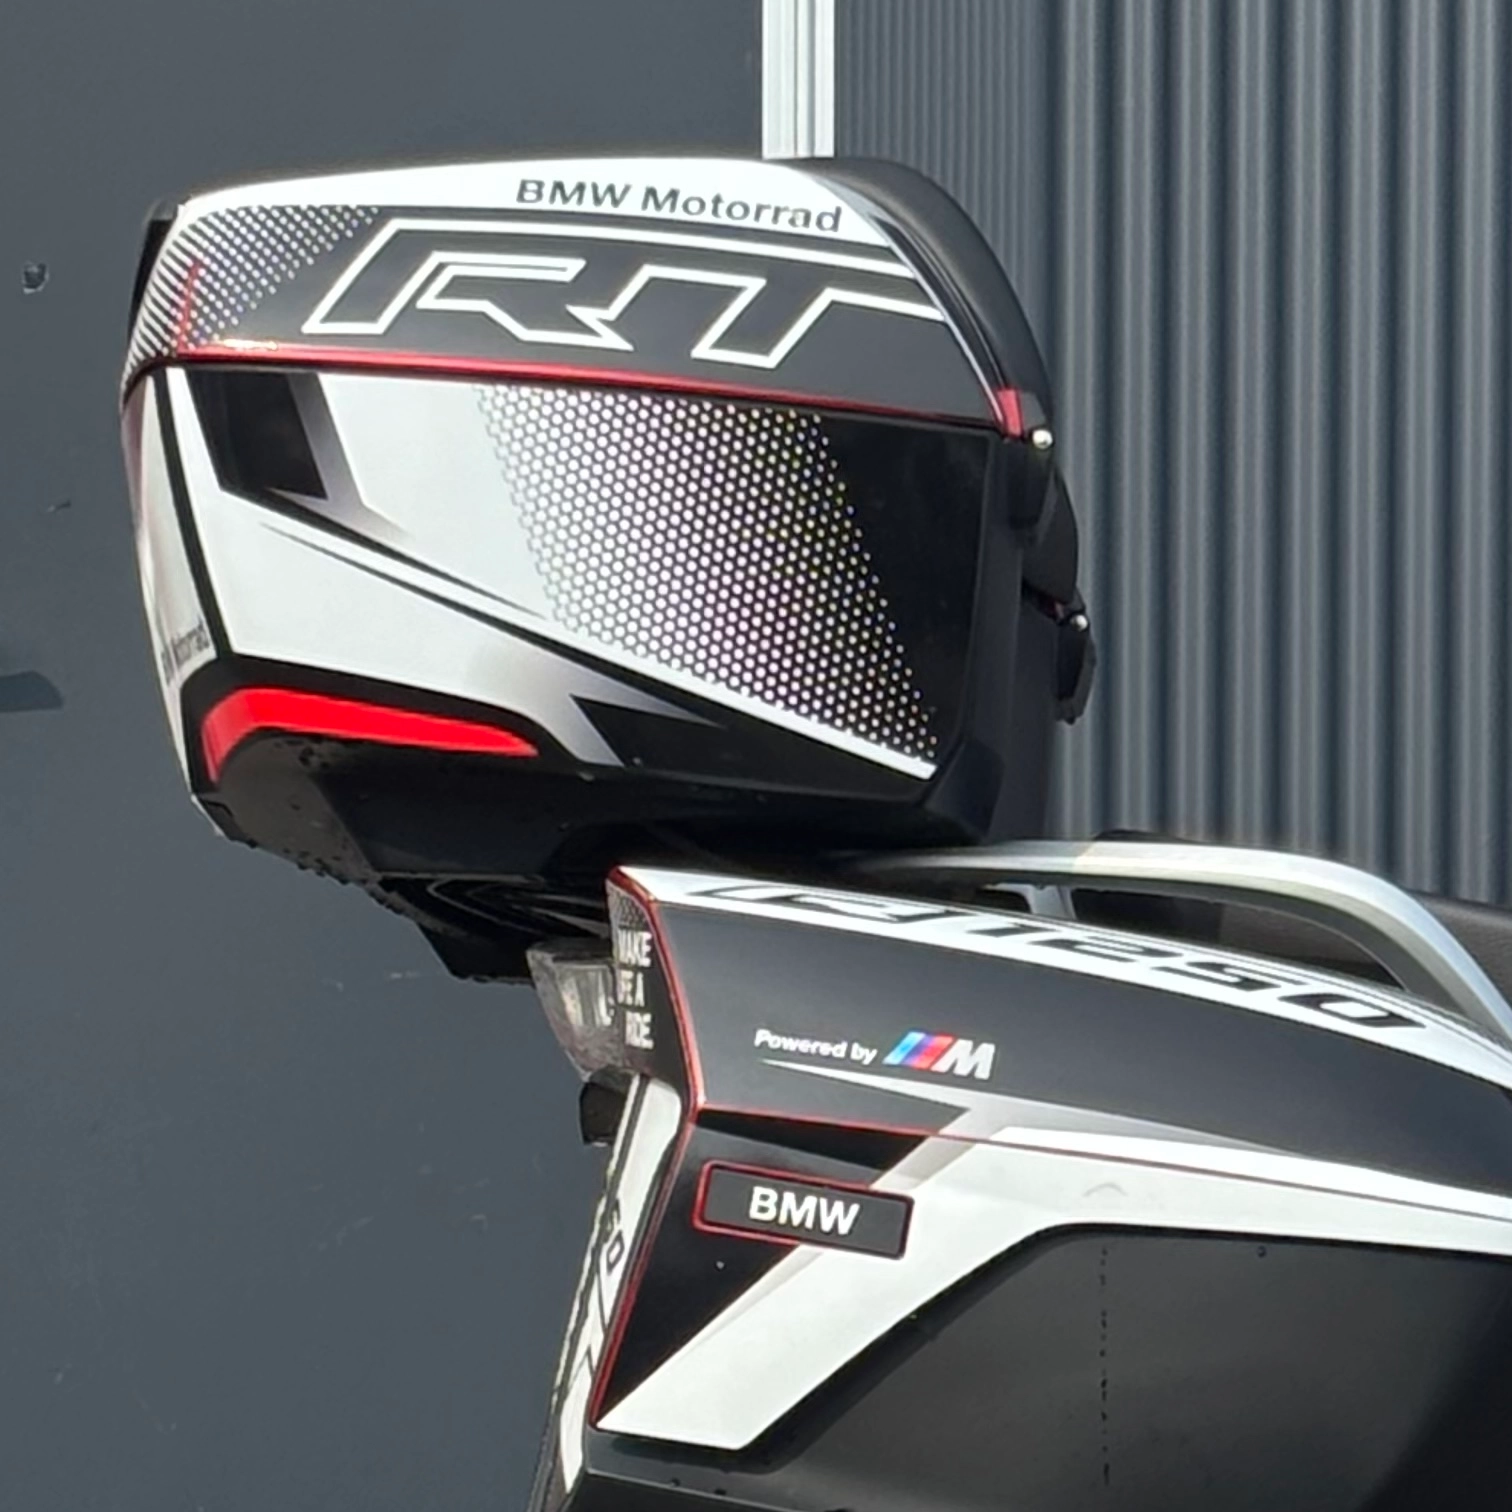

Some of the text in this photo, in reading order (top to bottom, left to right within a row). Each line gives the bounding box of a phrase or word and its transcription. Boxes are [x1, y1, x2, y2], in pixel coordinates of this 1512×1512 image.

[515, 178, 843, 232] BMW Motorrad
[754, 1029, 848, 1058] Powered
[850, 1042, 877, 1065] by
[749, 1186, 860, 1235] BMW
